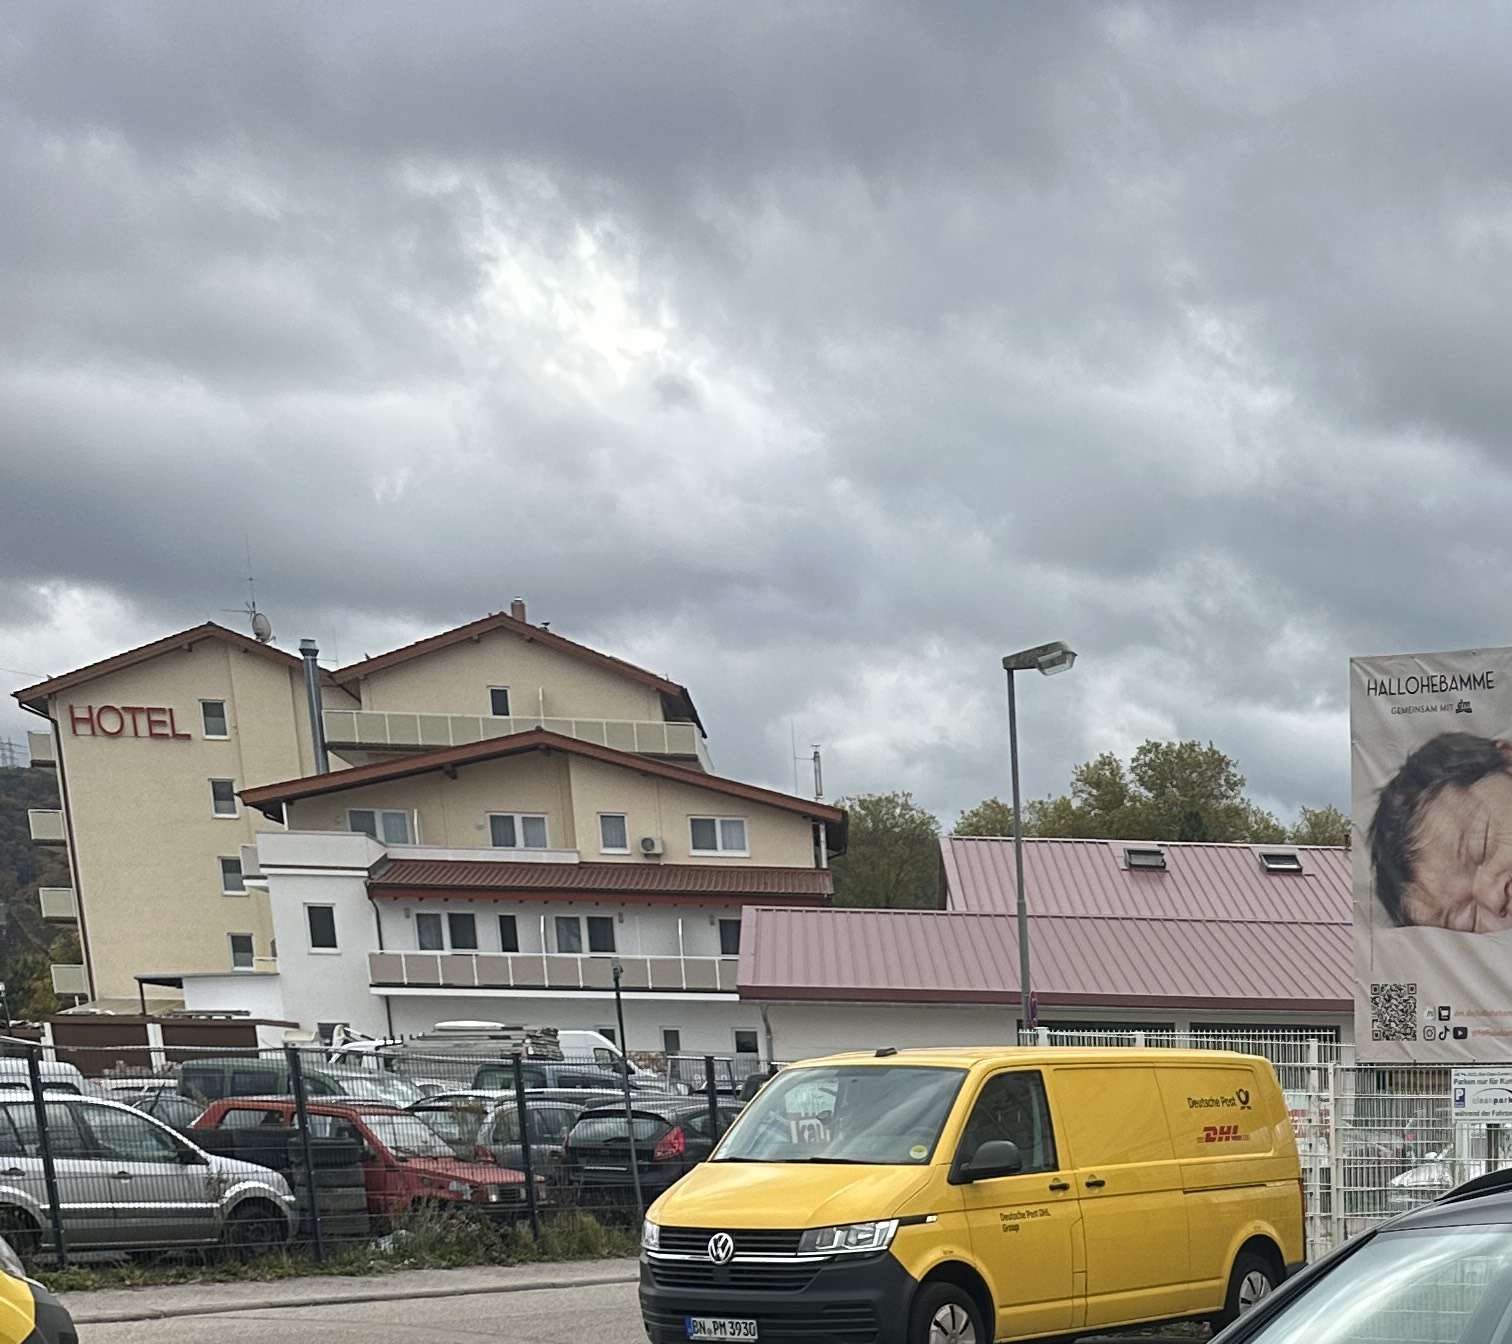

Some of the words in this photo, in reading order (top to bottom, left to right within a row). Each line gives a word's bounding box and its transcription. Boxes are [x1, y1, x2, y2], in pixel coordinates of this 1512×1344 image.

[1366, 671, 1496, 697] HALLOHEBAMME
[1390, 704, 1438, 715] GEMEINSAM
[1440, 703, 1455, 712] MIT
[68, 704, 192, 741] HOTEL
[1186, 1097, 1220, 1109] Deutsche
[1220, 1096, 1237, 1108] Post
[1202, 1124, 1240, 1143] DHL
[692, 1319, 706, 1335] BN
[712, 1320, 727, 1336] PM
[727, 1321, 756, 1337] 3930
